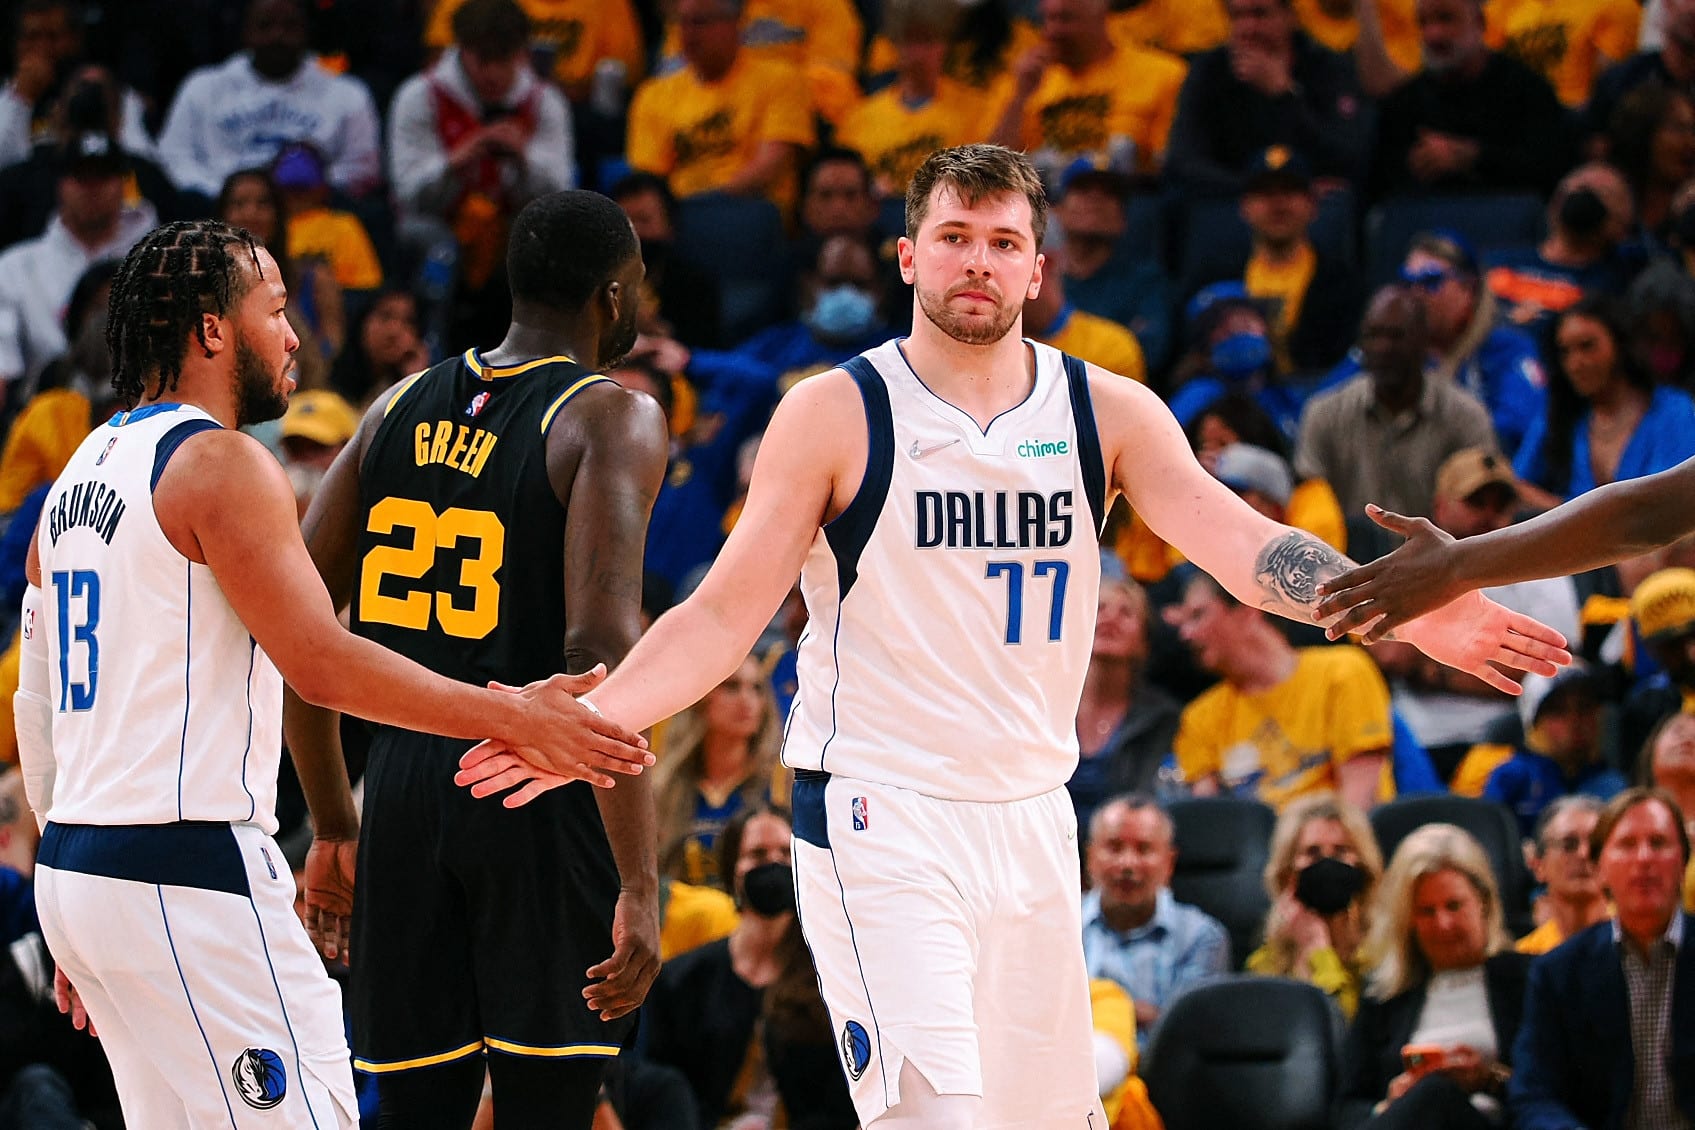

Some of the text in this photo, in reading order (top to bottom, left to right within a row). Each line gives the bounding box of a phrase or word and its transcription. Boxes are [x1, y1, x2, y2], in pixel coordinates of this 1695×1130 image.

[414, 420, 498, 478] GREEN
[1017, 439, 1069, 458] chime
[49, 480, 126, 548] BRUNSON
[914, 490, 1073, 550] DALLAS
[359, 496, 505, 640] 23
[984, 560, 1071, 645] 77
[51, 568, 101, 713] 13
